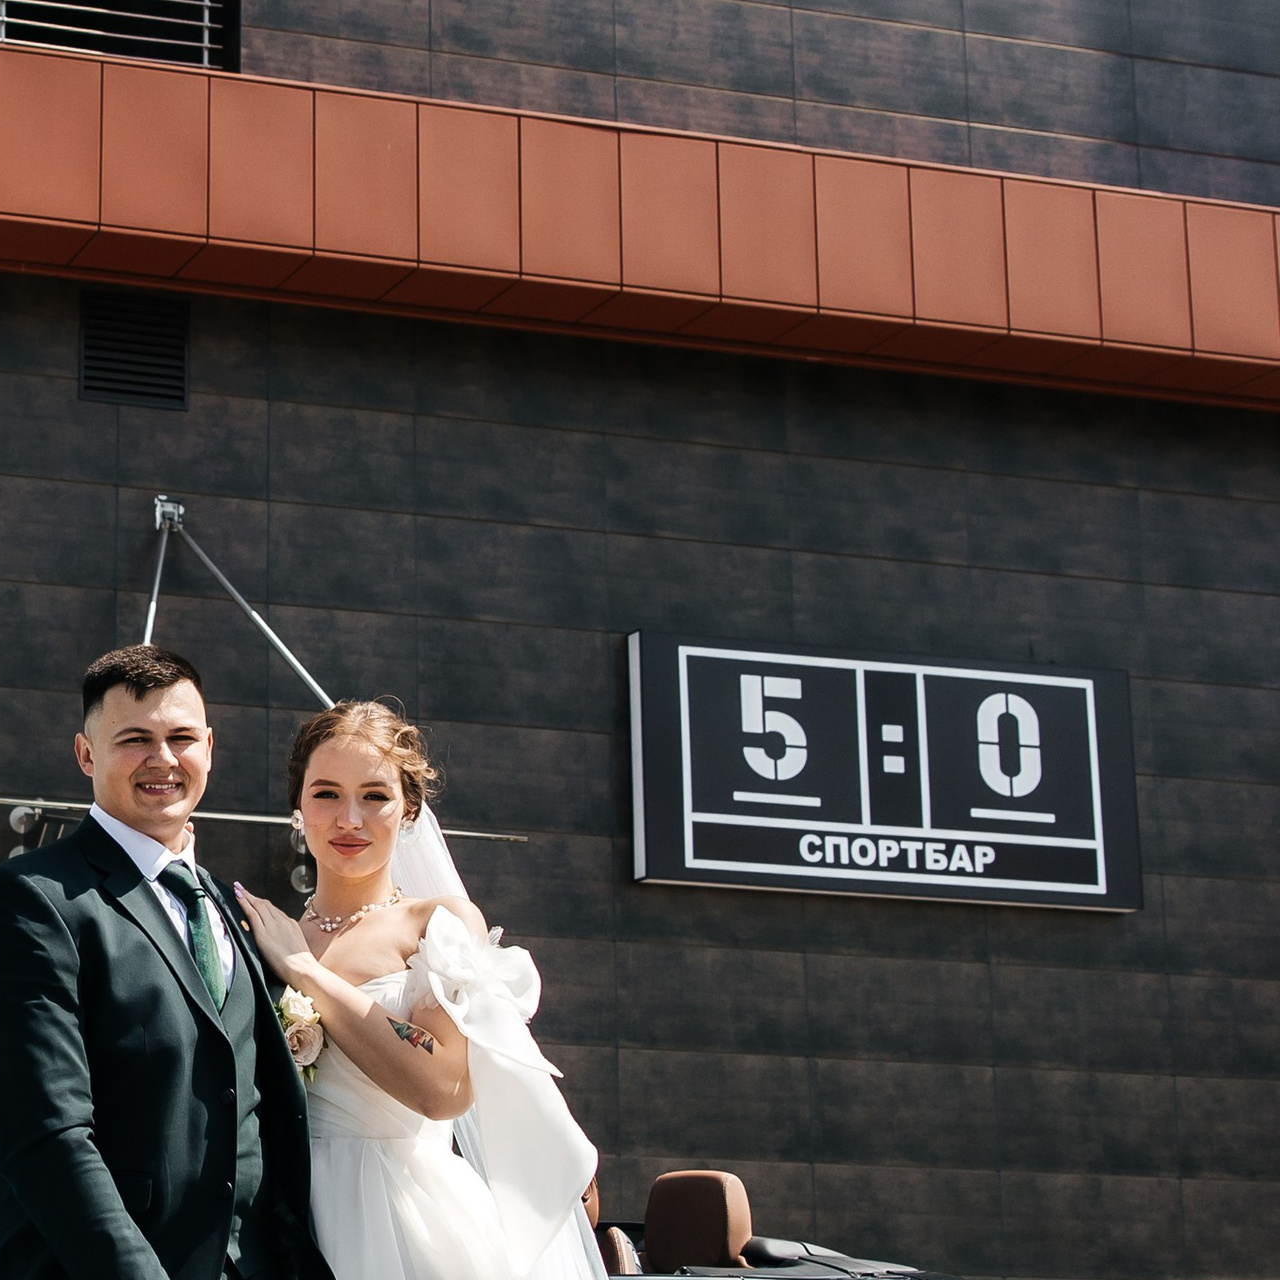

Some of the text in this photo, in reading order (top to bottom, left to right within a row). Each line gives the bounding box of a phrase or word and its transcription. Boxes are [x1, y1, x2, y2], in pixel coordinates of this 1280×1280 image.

[739, 673, 808, 781] 5
[976, 692, 1043, 798] 0
[798, 833, 996, 874] СПОРТБАР
